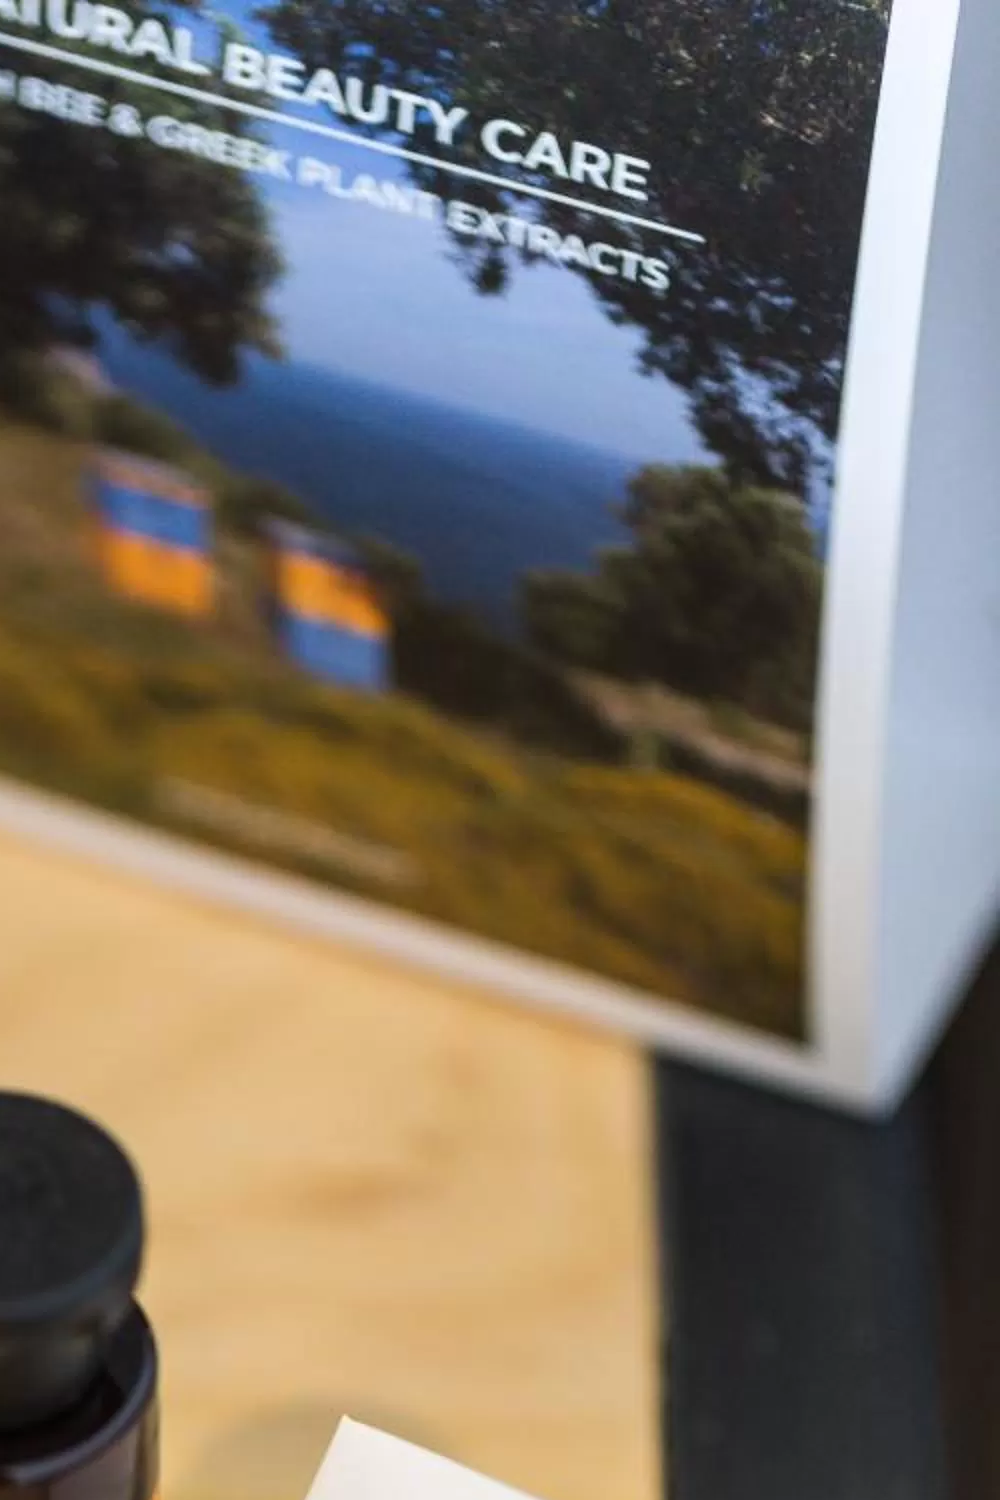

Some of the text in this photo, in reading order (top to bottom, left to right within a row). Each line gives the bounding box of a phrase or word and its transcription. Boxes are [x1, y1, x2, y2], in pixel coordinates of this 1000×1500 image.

[17, 75, 108, 127] BEE
[106, 103, 144, 138] &
[145, 114, 293, 181] GREEK
[296, 156, 442, 222] PLANT
[447, 199, 670, 291] EXTRACTS
[223, 42, 469, 145] BEAUTY
[480, 119, 651, 201] CARE
